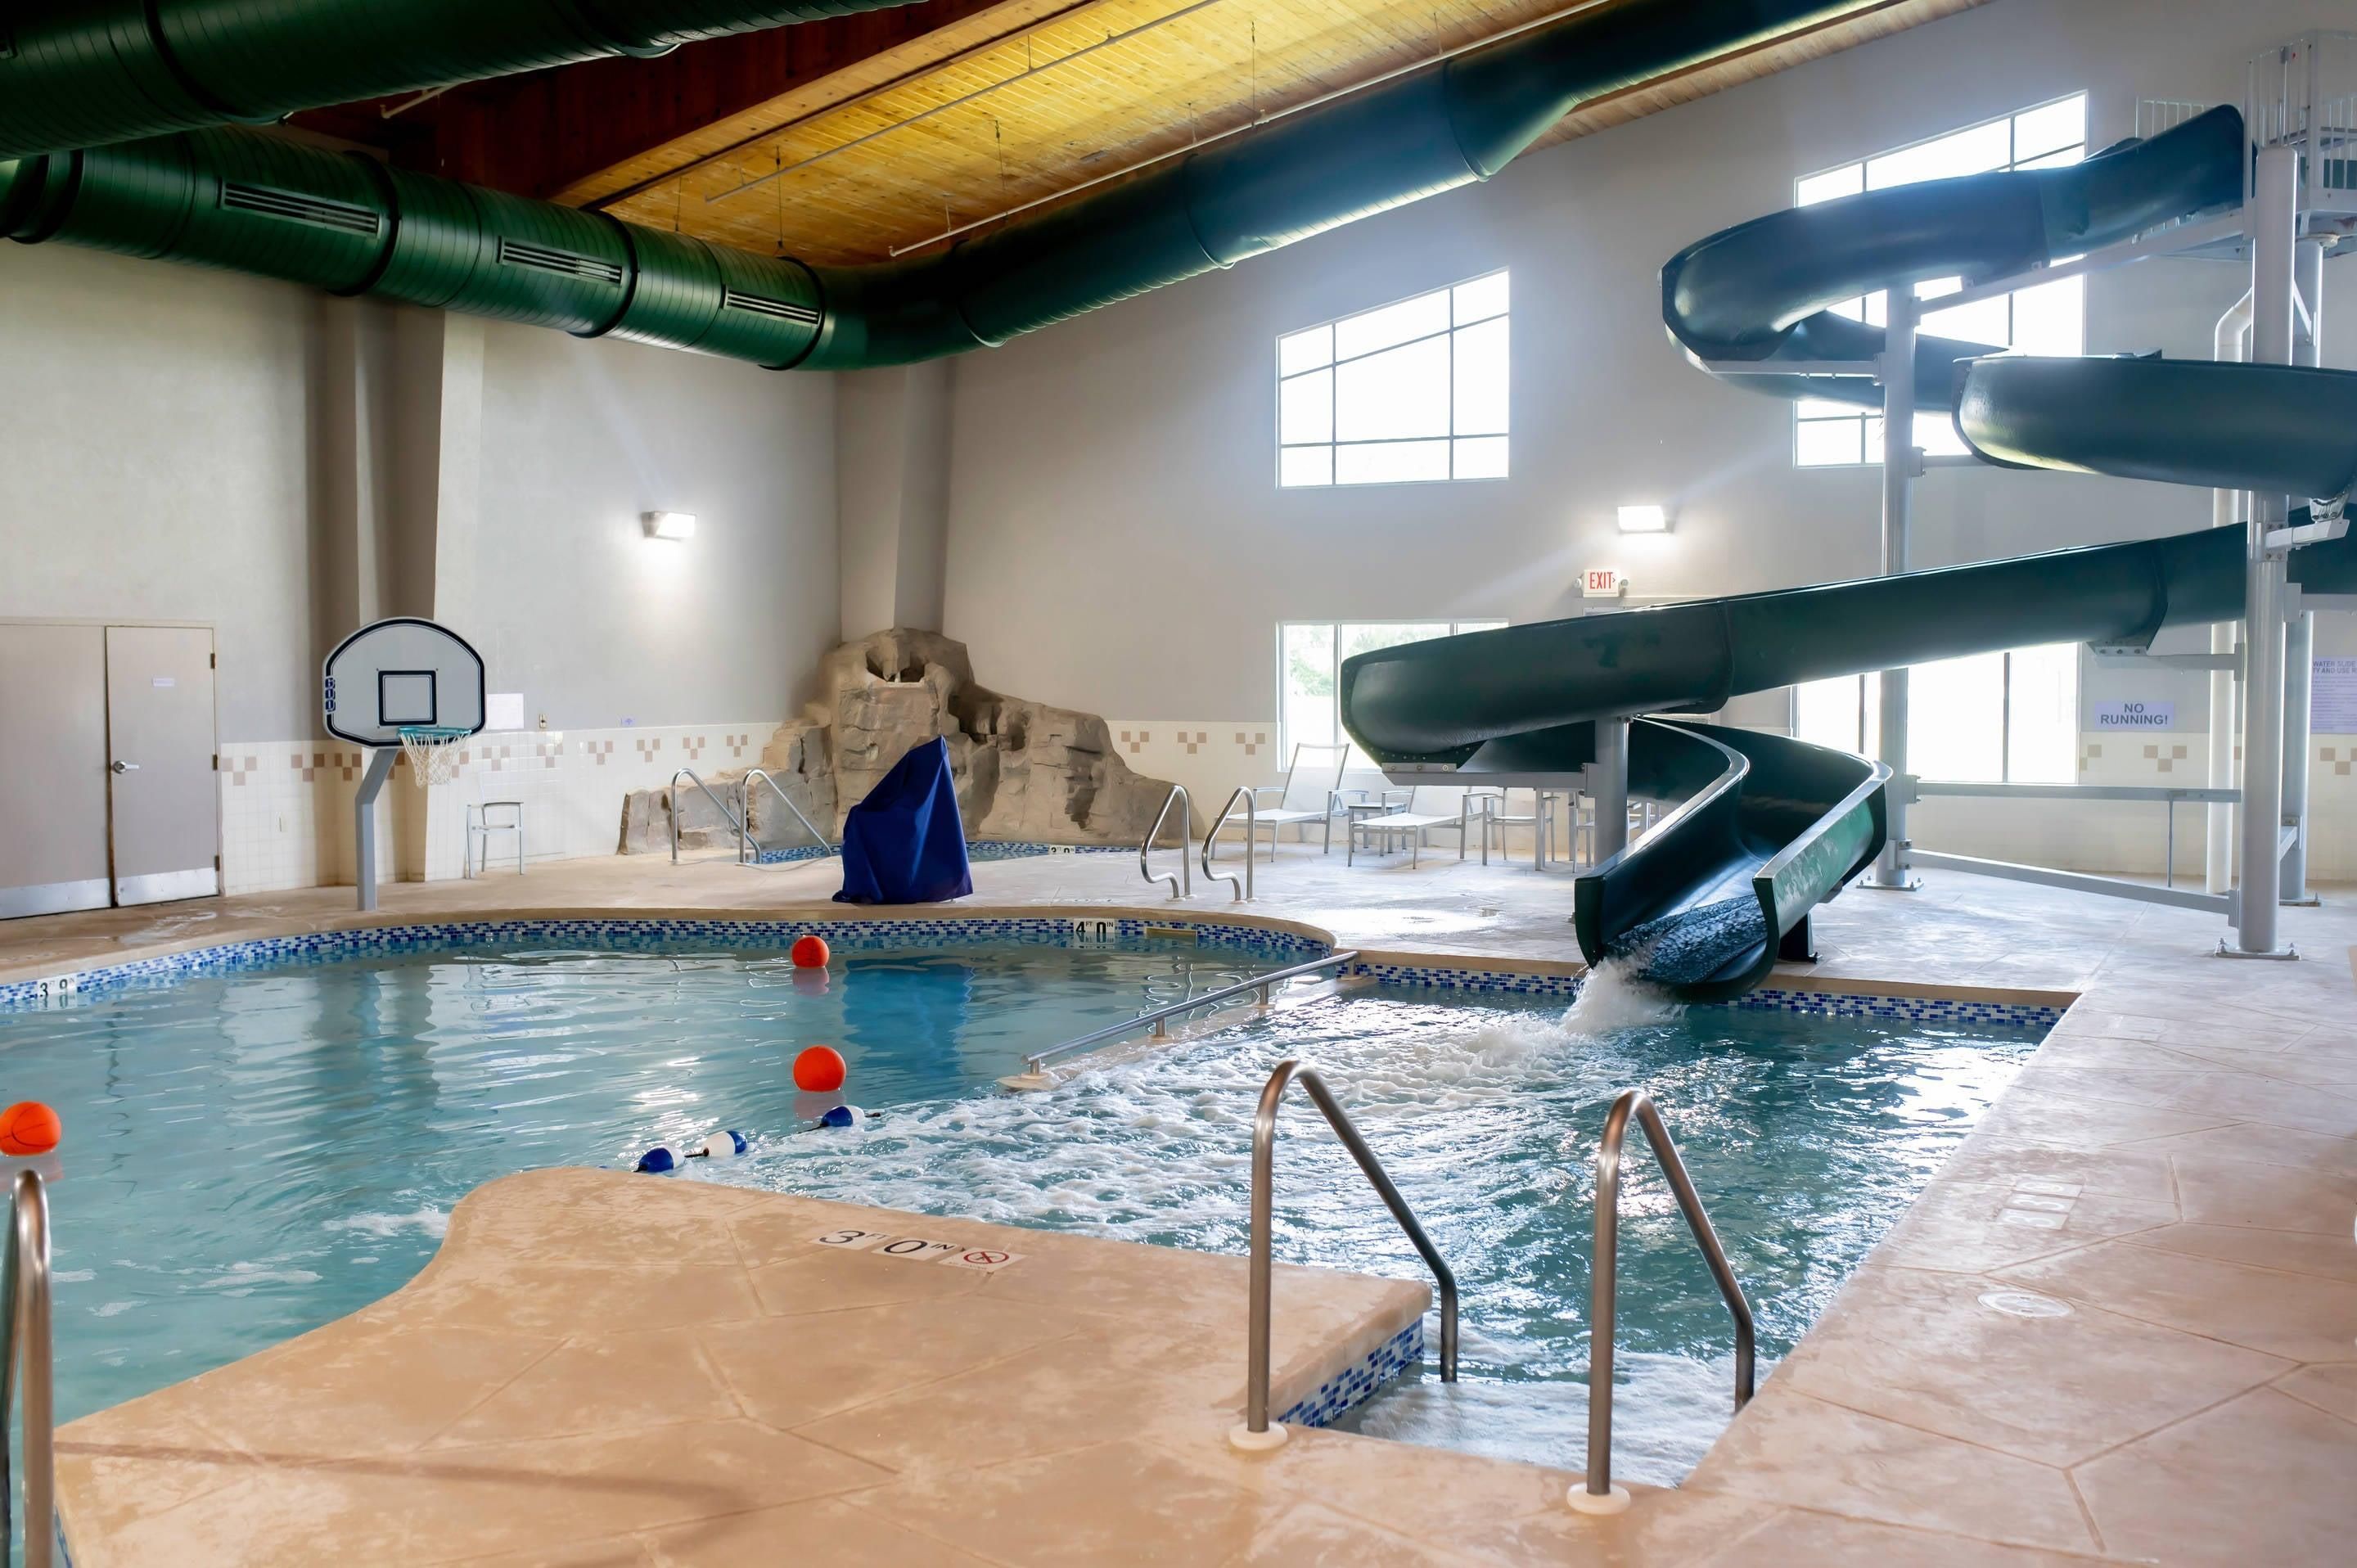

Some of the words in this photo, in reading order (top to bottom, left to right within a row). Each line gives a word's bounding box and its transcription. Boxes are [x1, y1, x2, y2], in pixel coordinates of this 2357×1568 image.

[1589, 571, 1613, 589] EXIT
[2124, 703, 2144, 714] NO
[2100, 714, 2168, 725] RUNNING!
[1075, 921, 1086, 932] 4
[40, 982, 48, 997] 3
[819, 1230, 866, 1244] 3
[883, 1240, 928, 1254] 0
